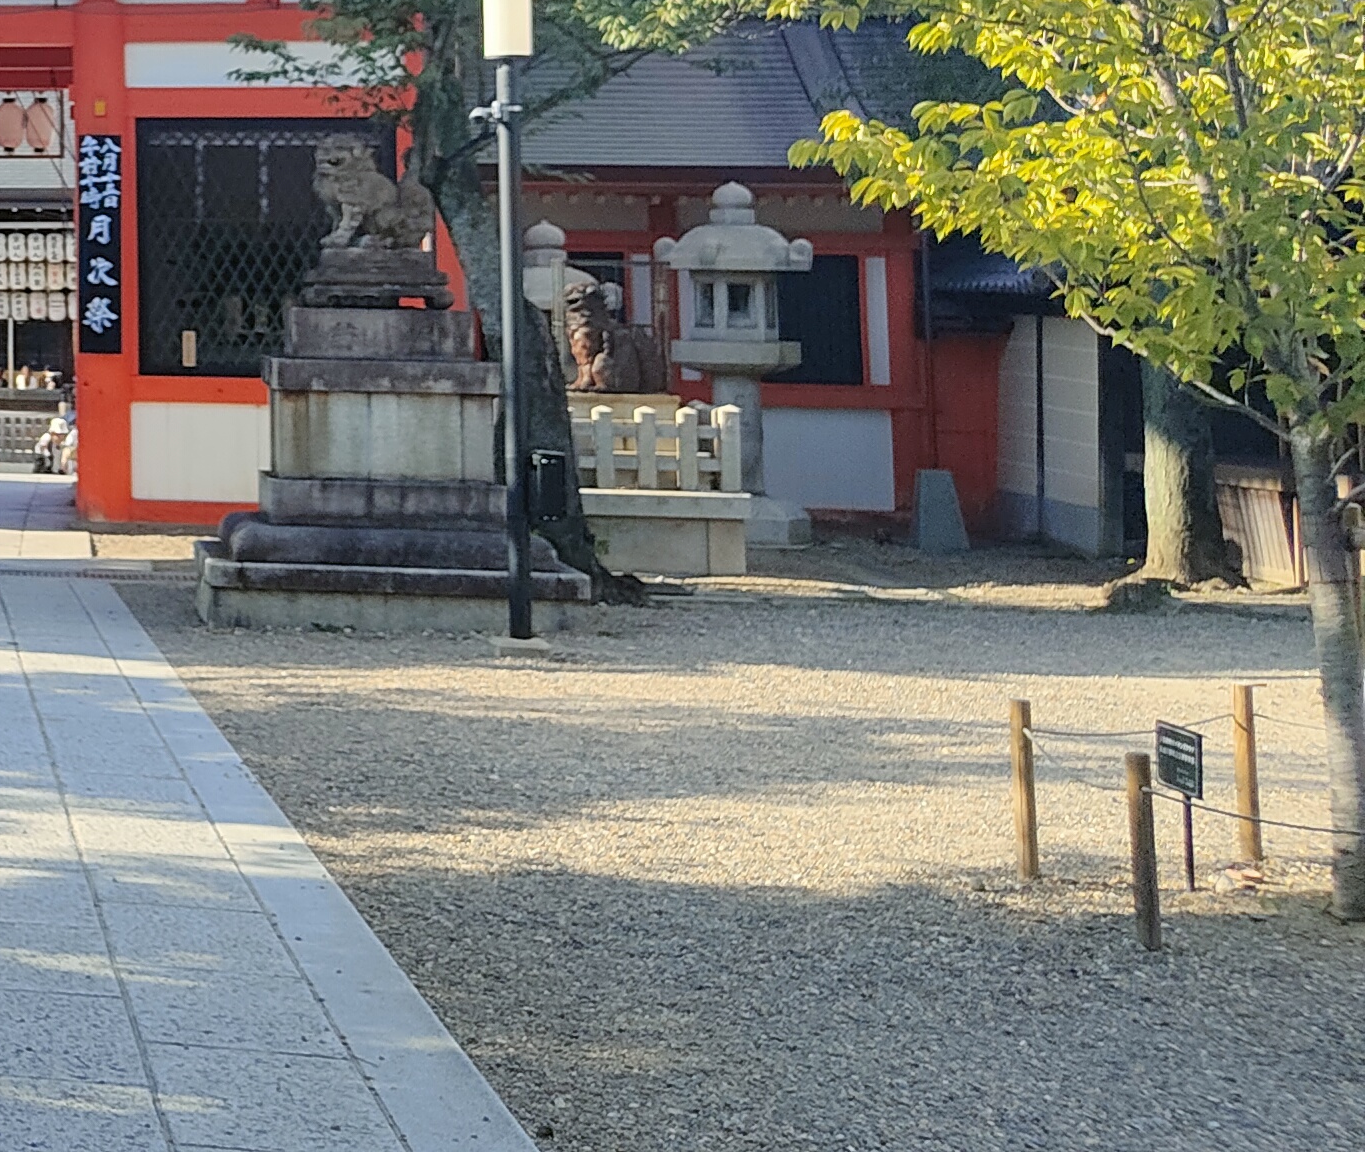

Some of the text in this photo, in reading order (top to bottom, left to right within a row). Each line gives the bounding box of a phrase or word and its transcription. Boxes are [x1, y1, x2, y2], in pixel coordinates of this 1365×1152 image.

[79, 135, 101, 209] 午前十時
[82, 214, 119, 334] 月次祭
